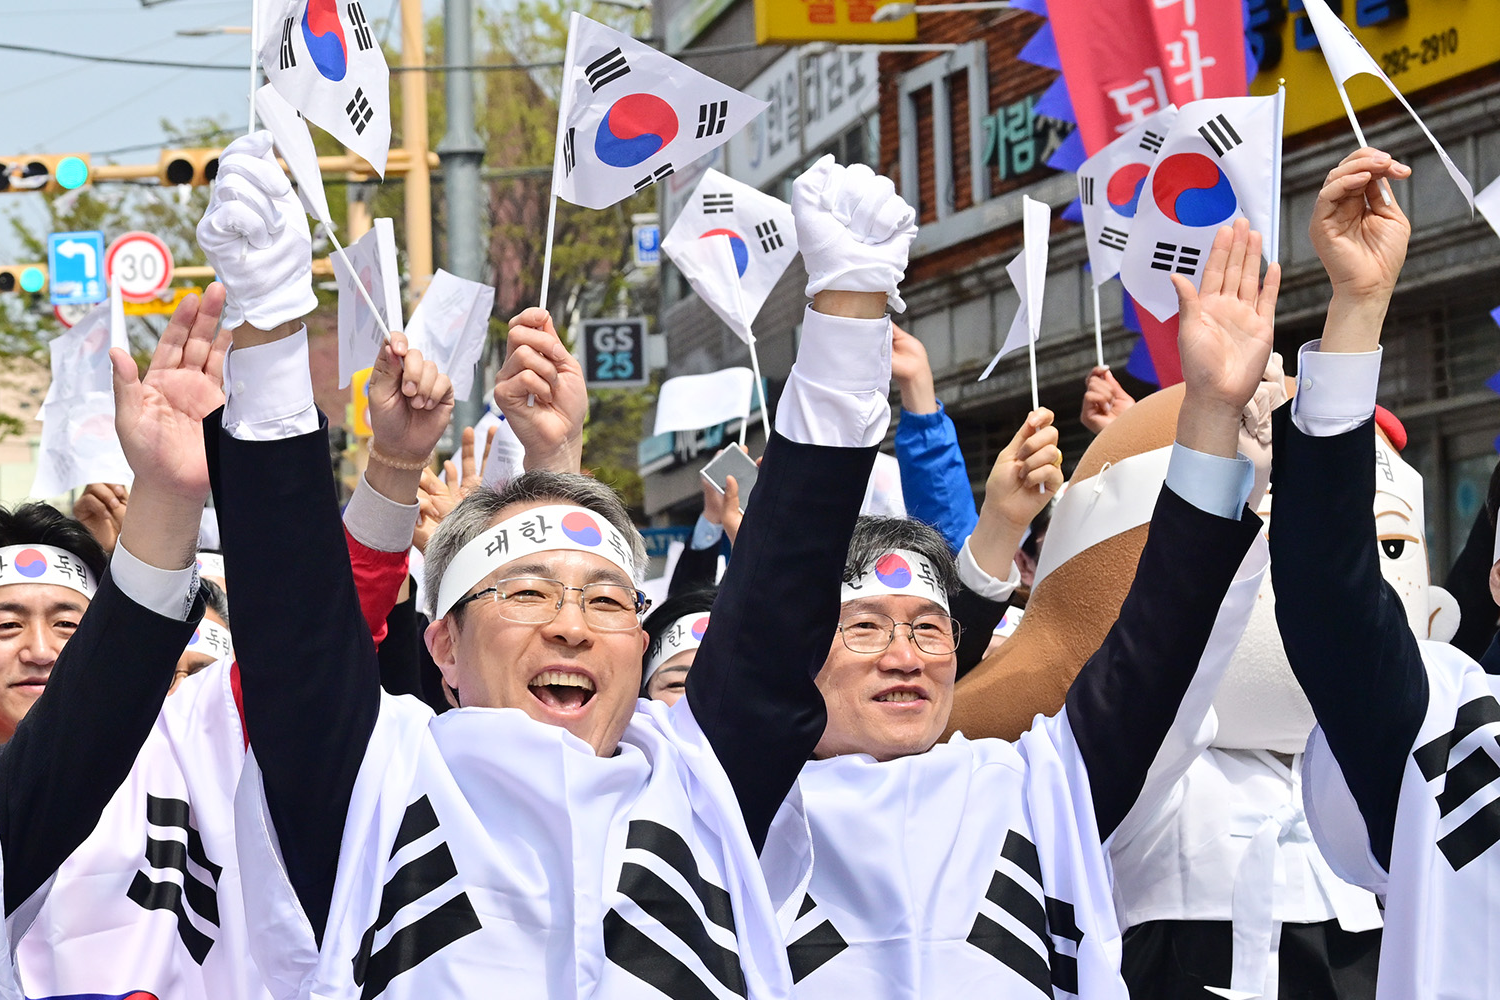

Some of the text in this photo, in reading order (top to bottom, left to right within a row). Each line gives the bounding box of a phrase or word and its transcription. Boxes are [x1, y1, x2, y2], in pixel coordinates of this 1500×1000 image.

[121, 253, 157, 282] 30
[593, 326, 634, 352] GS
[596, 352, 635, 379] 25
[484, 514, 553, 558] 대한
[651, 624, 686, 661] 대한
